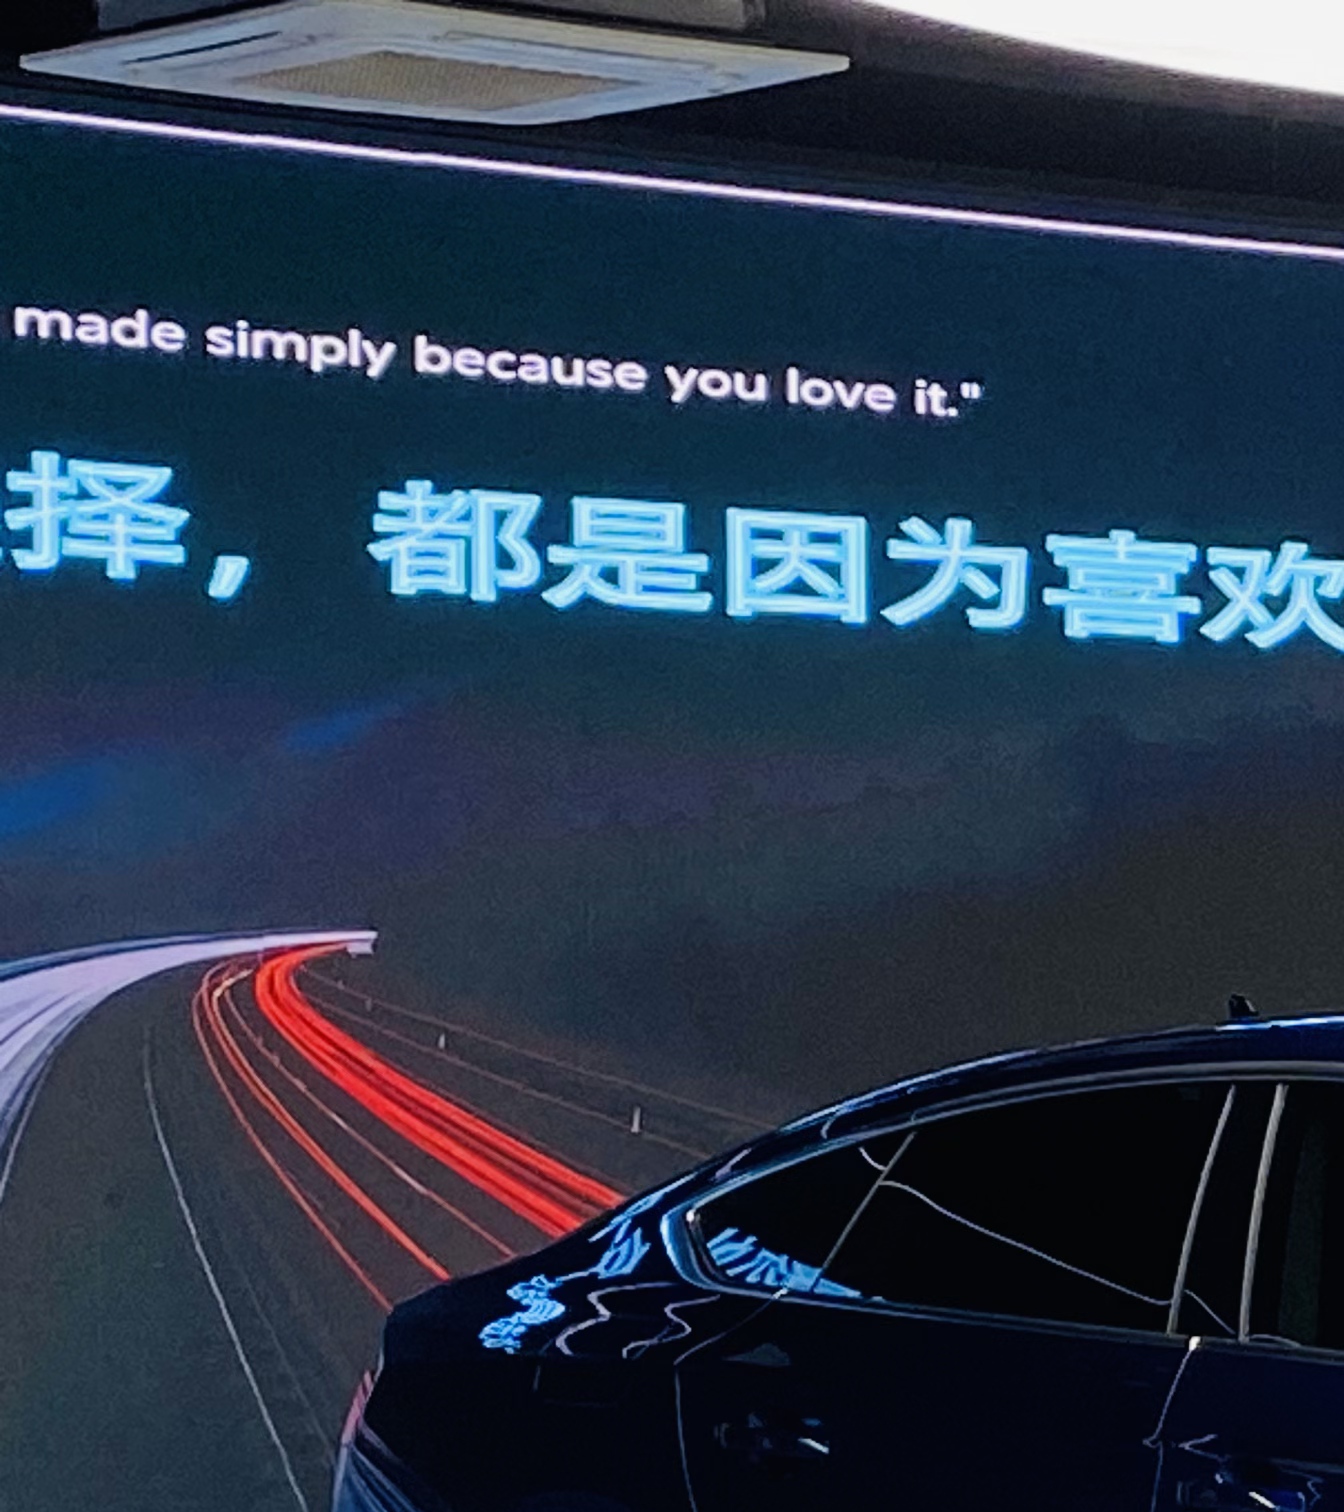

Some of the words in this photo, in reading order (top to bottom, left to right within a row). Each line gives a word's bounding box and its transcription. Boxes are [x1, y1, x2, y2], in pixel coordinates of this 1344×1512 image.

[13, 305, 188, 353] made
[204, 318, 397, 379] simply
[413, 333, 650, 391] because
[663, 364, 769, 404] you
[785, 366, 897, 413] love
